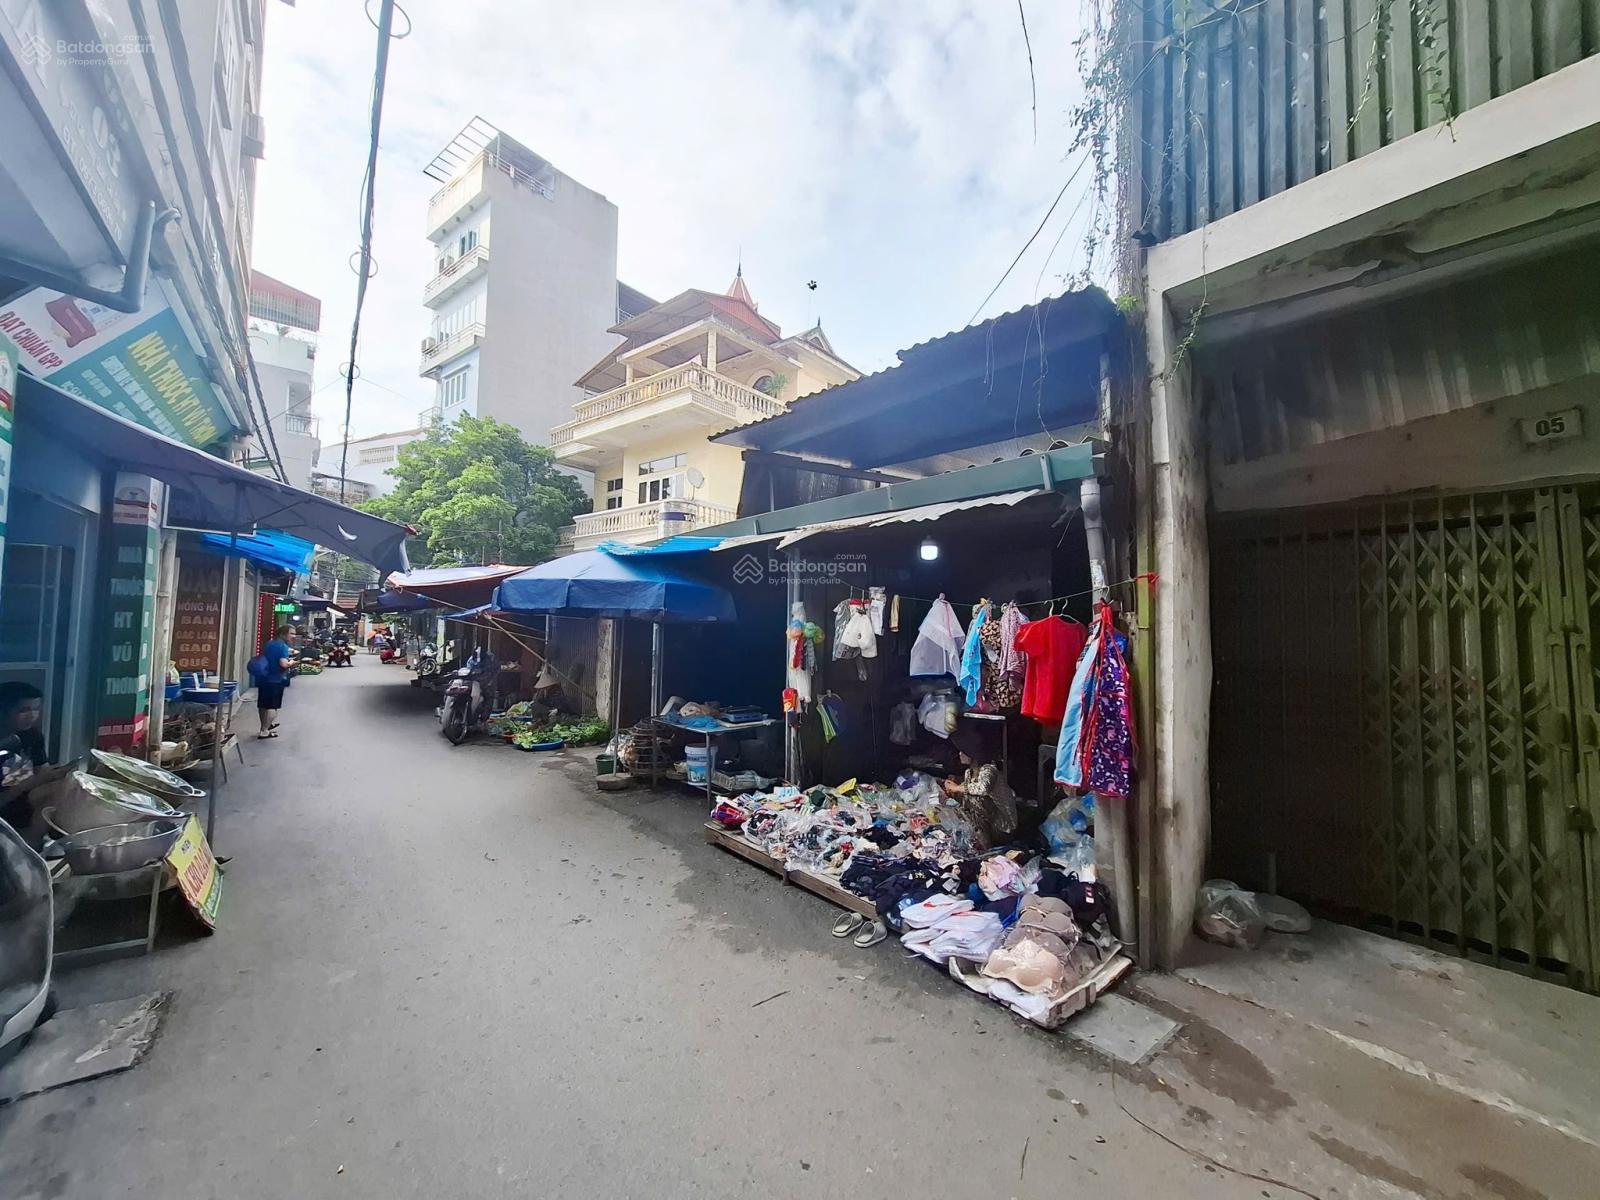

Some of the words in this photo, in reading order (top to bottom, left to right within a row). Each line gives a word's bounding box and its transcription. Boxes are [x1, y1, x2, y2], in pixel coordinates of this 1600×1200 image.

[128, 330, 178, 372] NHÀ
[1535, 416, 1565, 436] 05
[113, 611, 134, 629] HT
